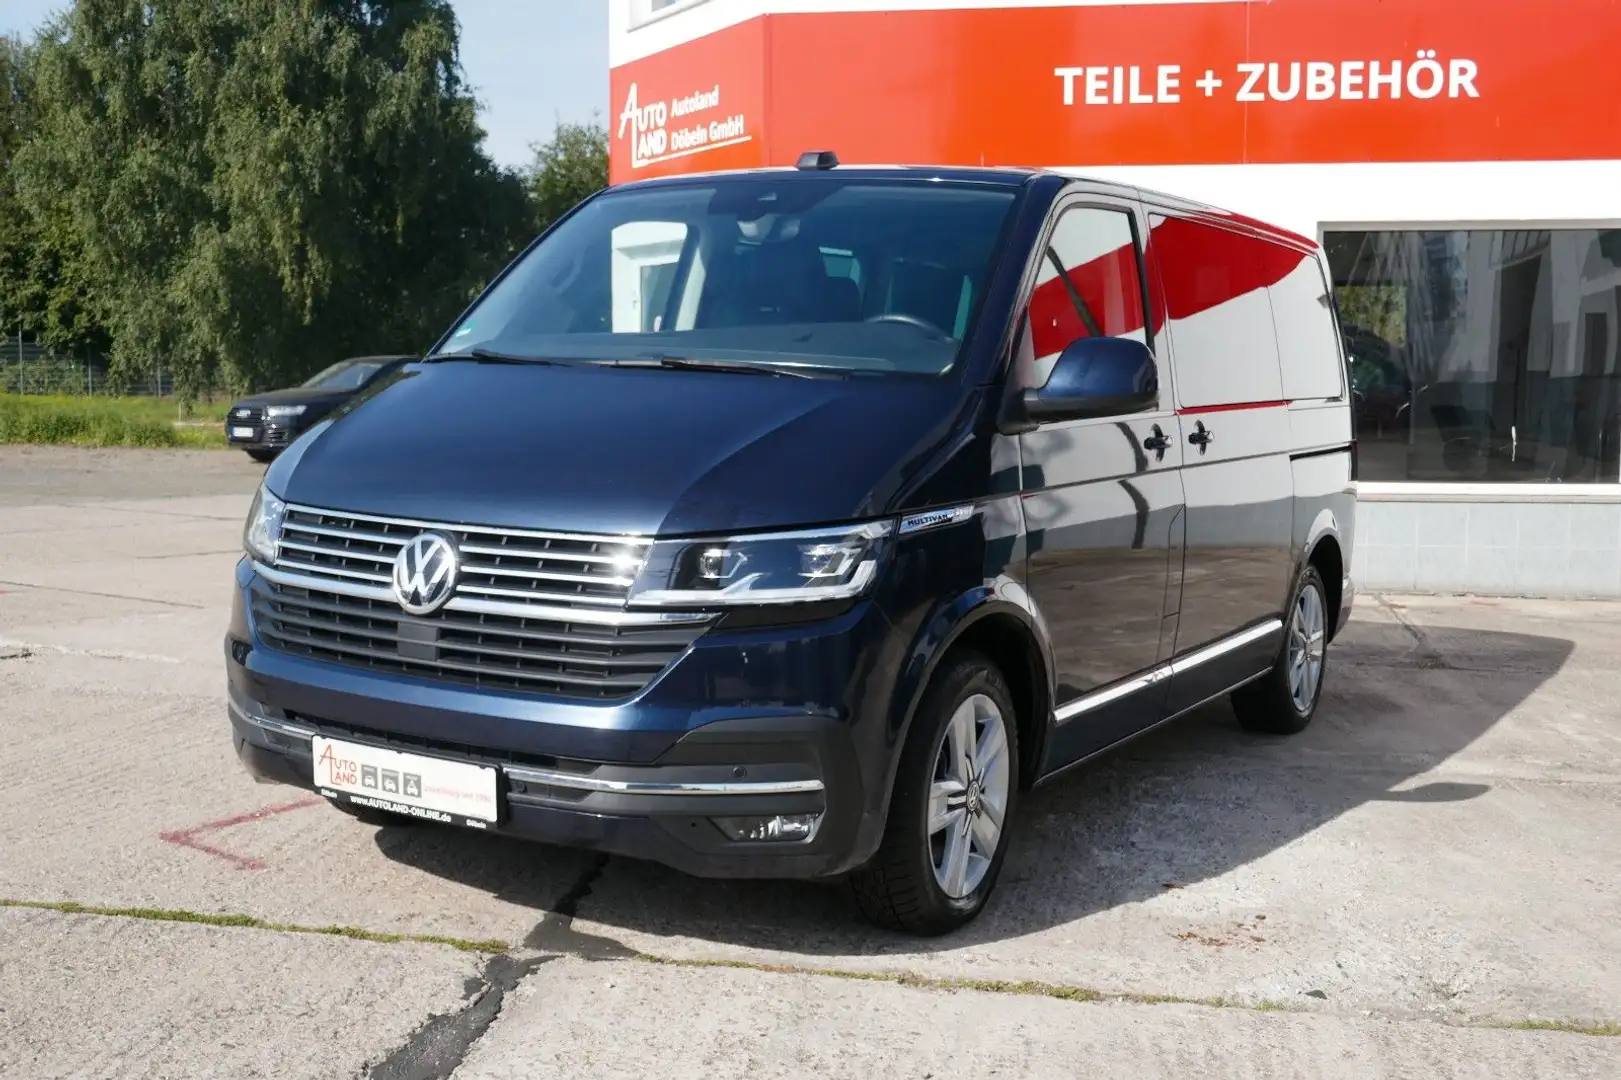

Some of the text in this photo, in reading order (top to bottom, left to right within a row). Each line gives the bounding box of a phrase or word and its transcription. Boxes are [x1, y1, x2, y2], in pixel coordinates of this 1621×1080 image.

[1054, 49, 1480, 105] TEILE + ZUBEHÖR
[618, 82, 667, 139] AUTO
[670, 84, 719, 118] Autoland
[671, 114, 744, 150] Döbeln GmbH
[908, 514, 948, 526] MULTIVAN
[396, 535, 453, 610] VW
[319, 744, 357, 773] AUTO
[350, 796, 452, 823] www.AUTOLAND-ONLINE.de
